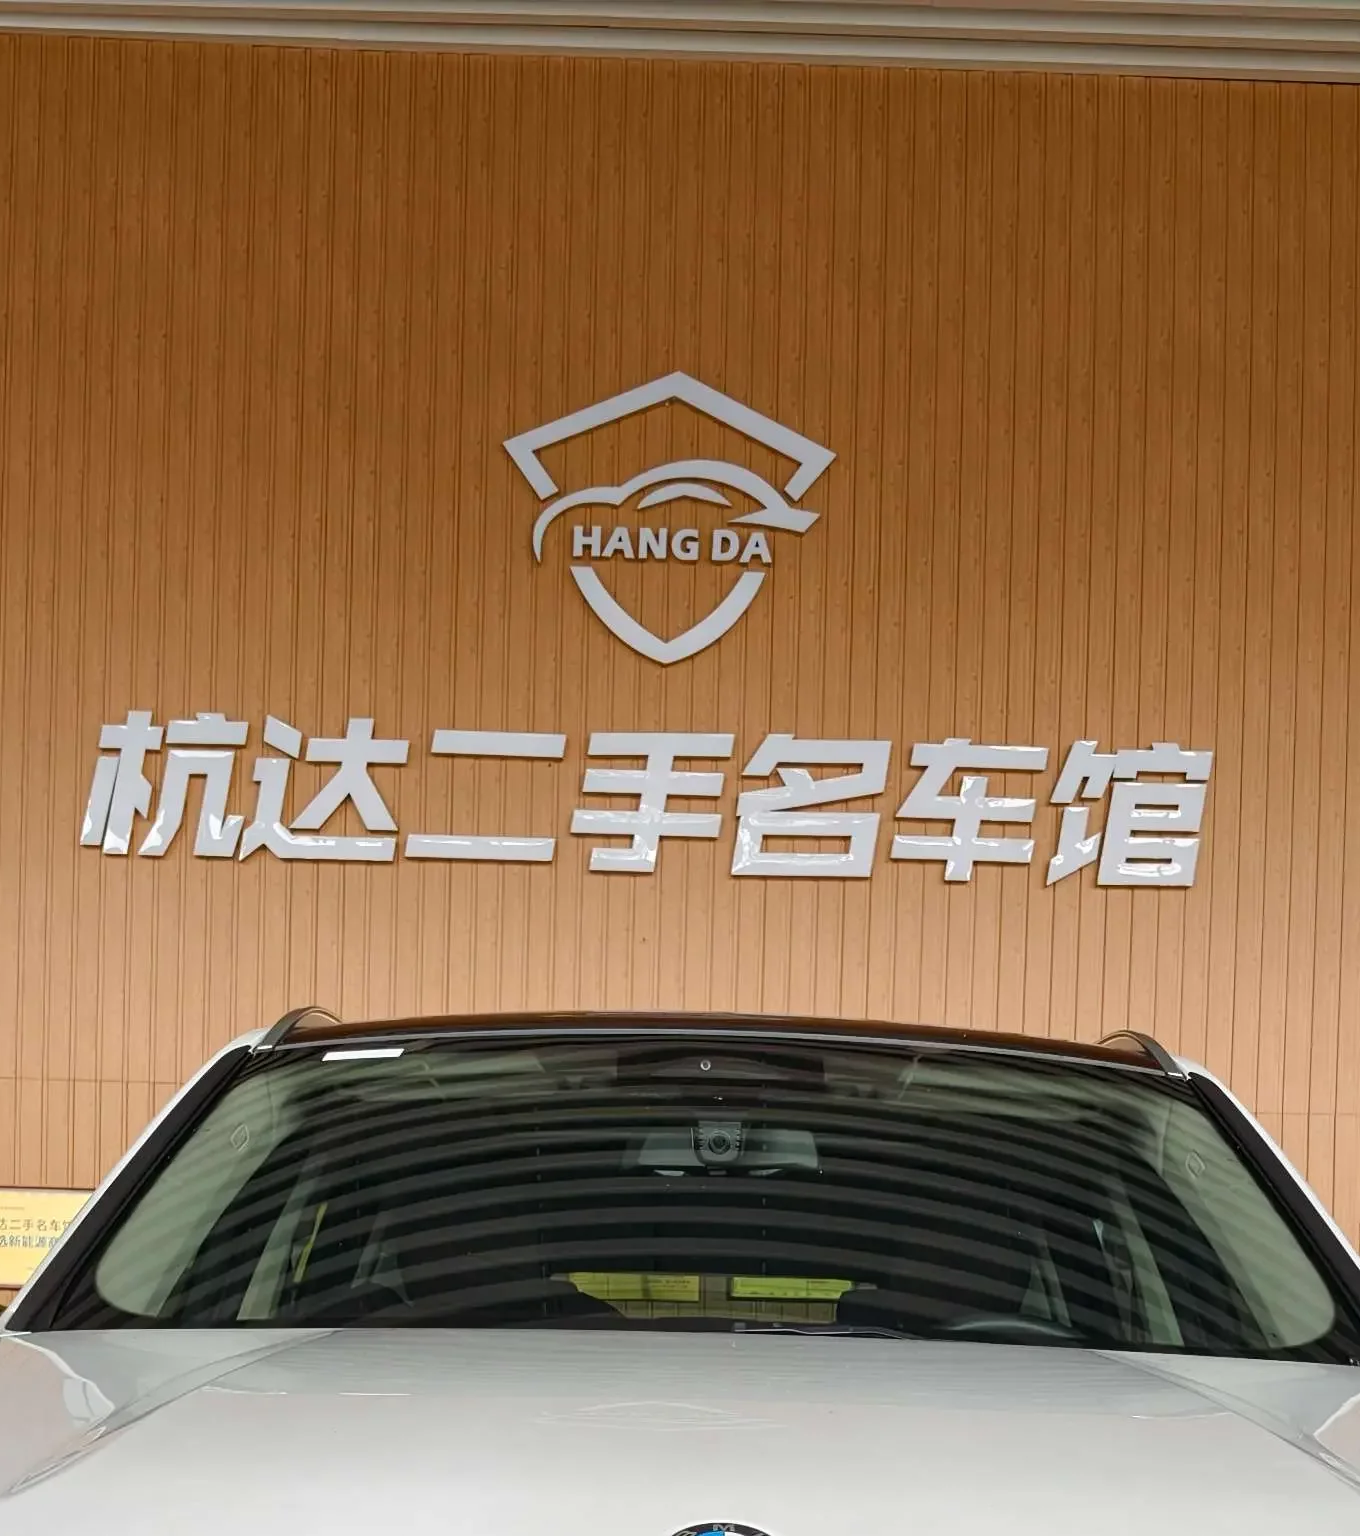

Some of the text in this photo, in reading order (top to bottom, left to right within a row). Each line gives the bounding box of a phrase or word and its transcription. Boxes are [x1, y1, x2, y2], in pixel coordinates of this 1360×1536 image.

[571, 524, 773, 566] HANG DA
[79, 708, 1215, 890] 杭达二手名车馆
